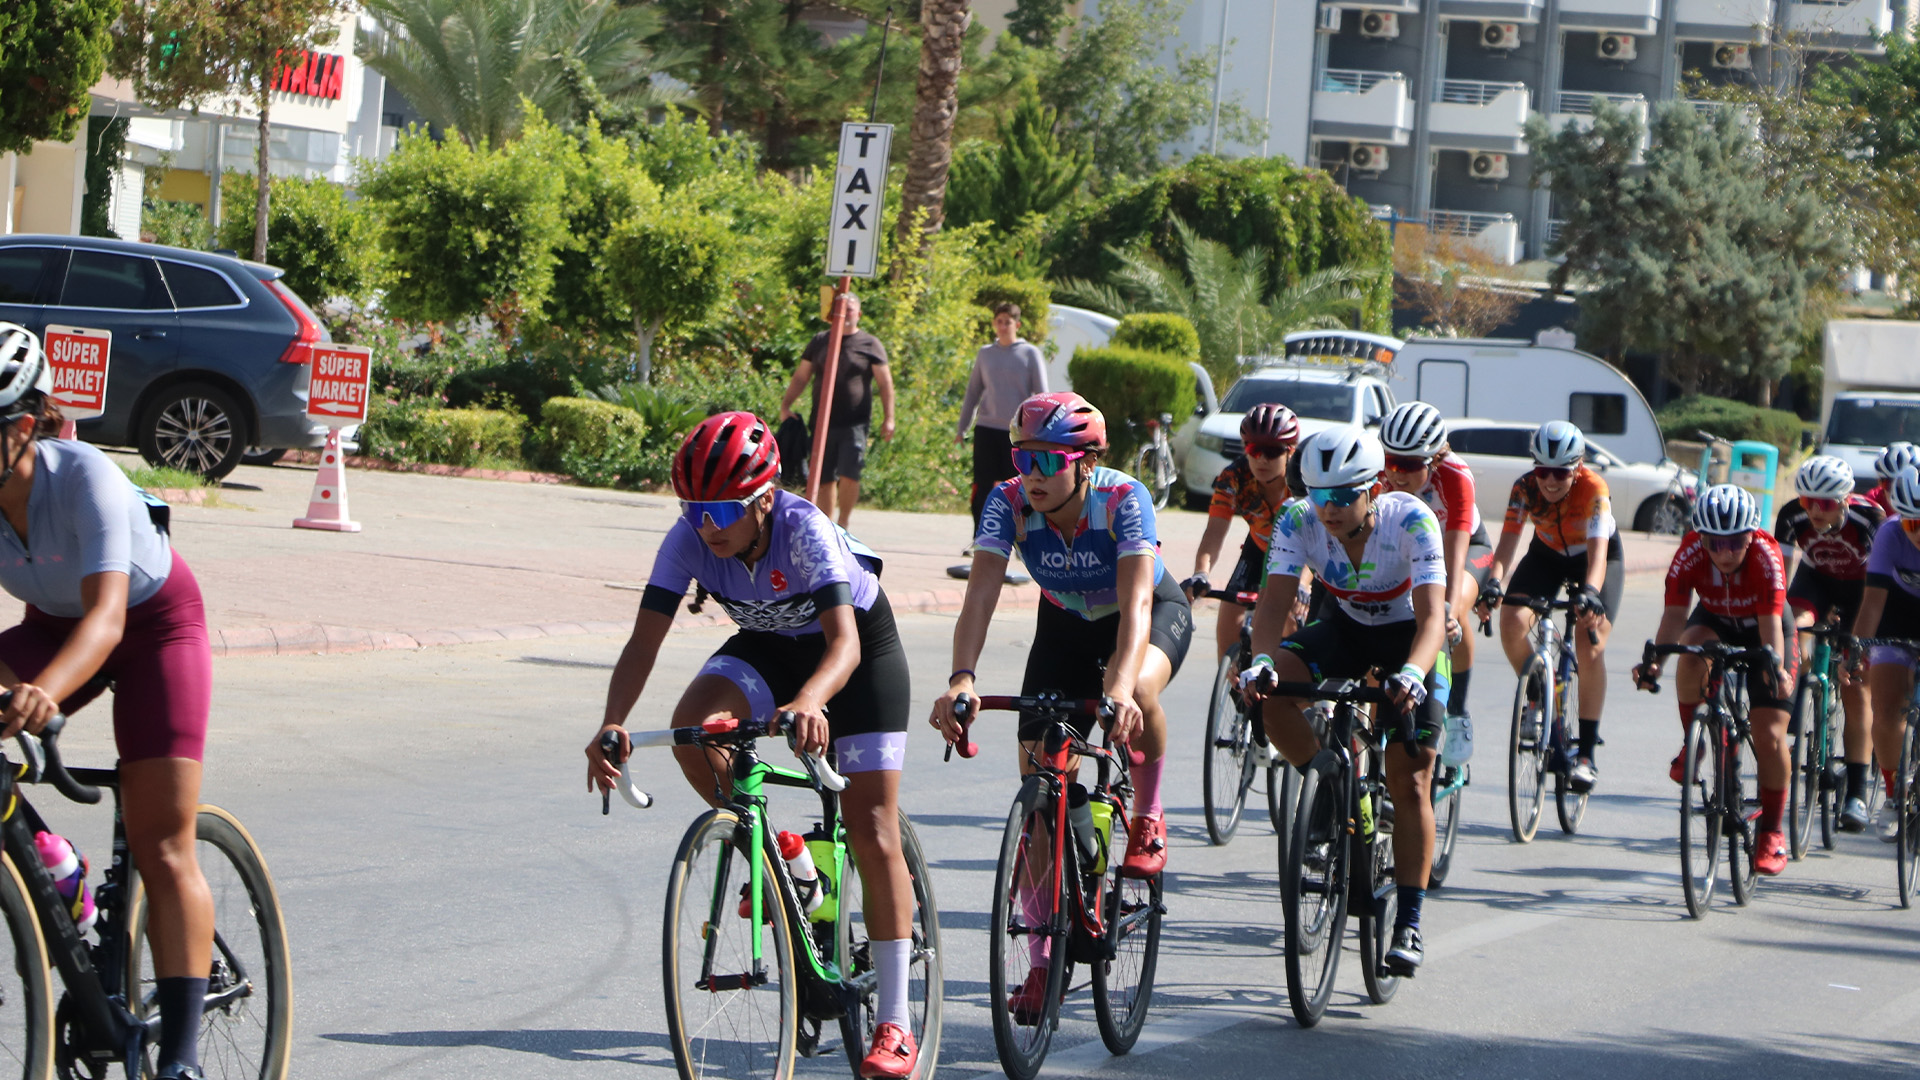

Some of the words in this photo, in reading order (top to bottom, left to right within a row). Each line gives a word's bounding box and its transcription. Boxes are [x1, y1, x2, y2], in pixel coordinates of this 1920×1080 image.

[841, 131, 877, 266] TAXI
[52, 337, 100, 365] SÜPER
[319, 353, 362, 378] SÜPER
[311, 379, 365, 403] MARKET
[1046, 402, 1067, 431] MET
[982, 495, 1010, 541] KONYA
[1041, 550, 1102, 569] KONYA
[1081, 564, 1112, 579] SPOR
